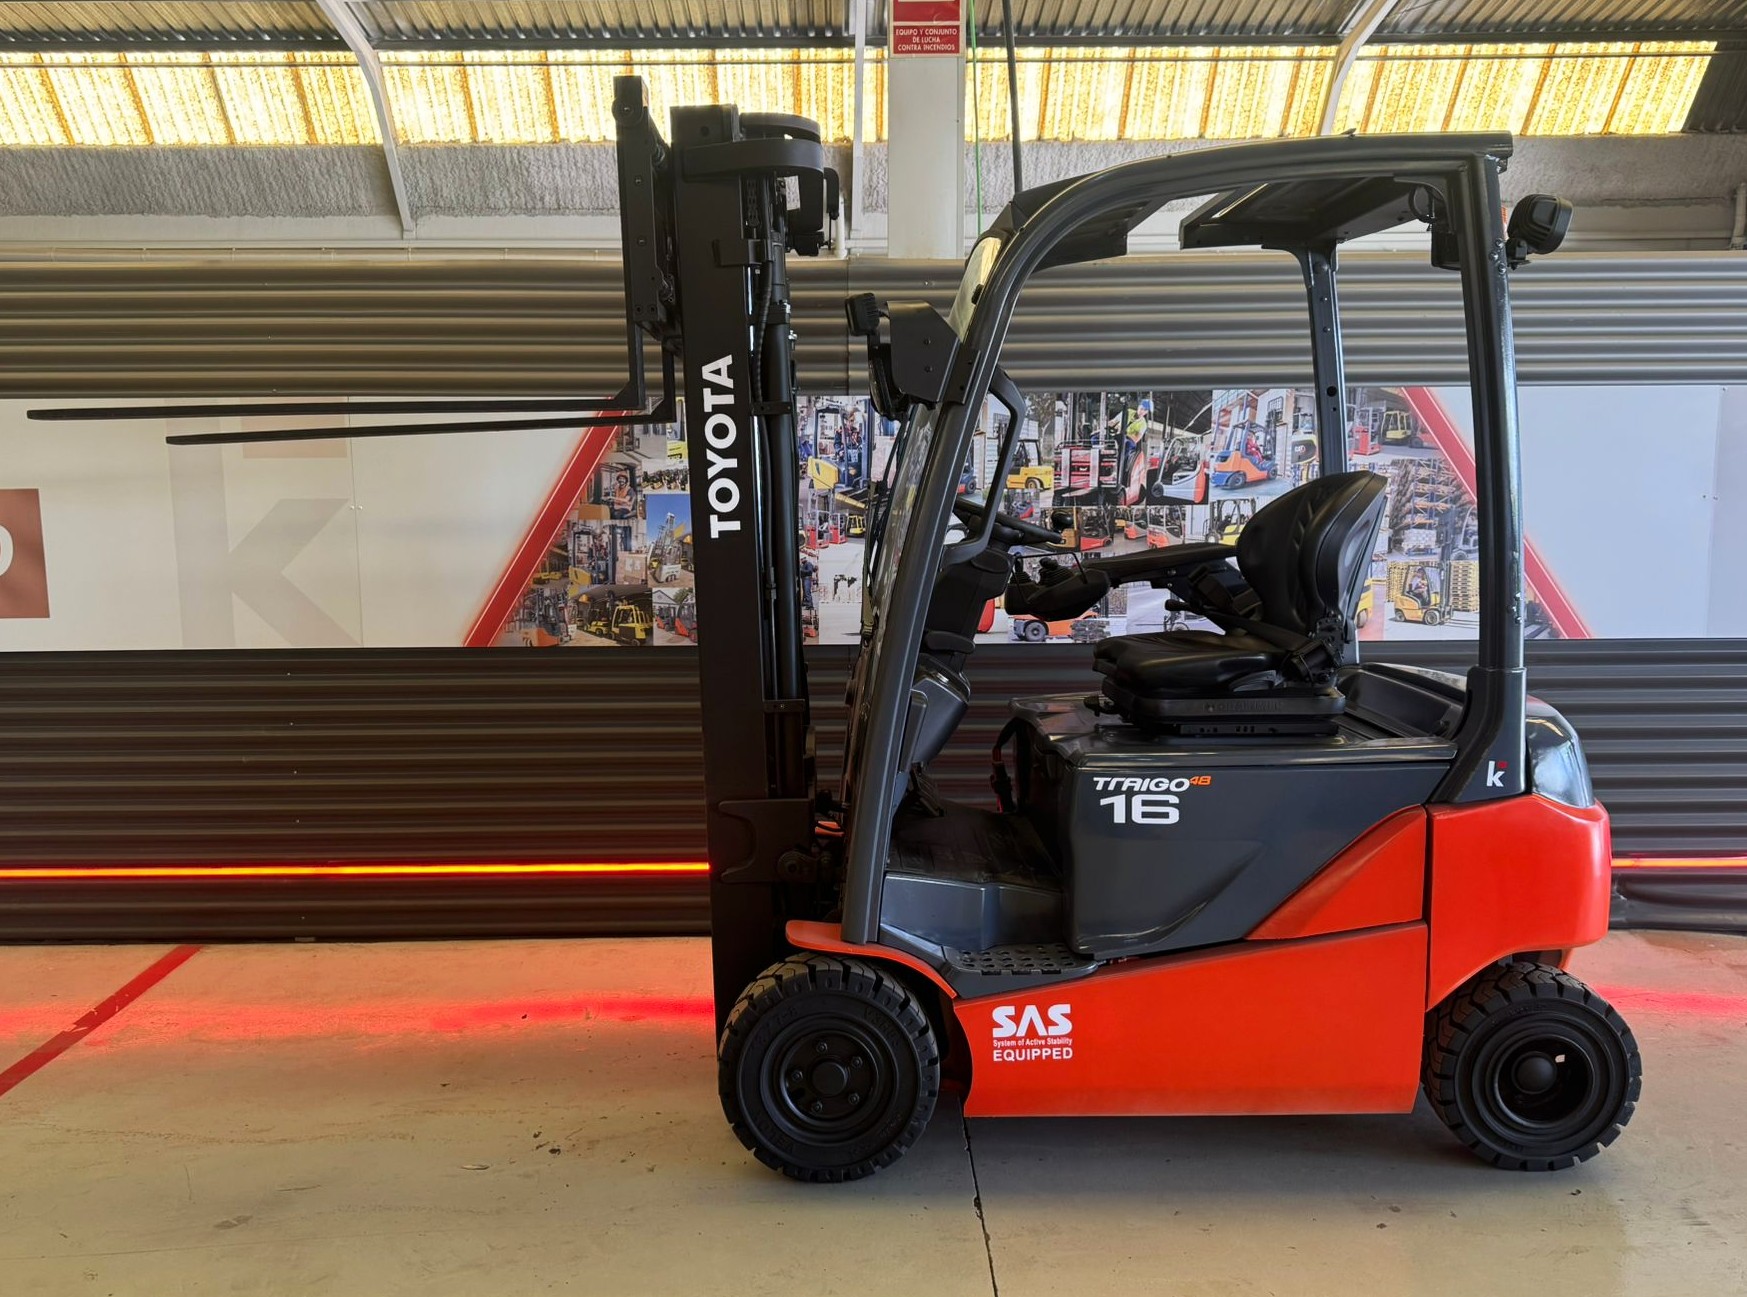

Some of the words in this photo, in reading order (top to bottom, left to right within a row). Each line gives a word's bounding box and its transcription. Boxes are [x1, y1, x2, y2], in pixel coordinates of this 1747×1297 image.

[896, 28, 918, 36] EQUIPO
[925, 28, 958, 36] CONJUNTO
[701, 354, 742, 539] TOYOTA
[1100, 794, 1180, 824] 16
[992, 1004, 1073, 1038] SAS
[993, 1039, 1017, 1049] System
[1018, 1039, 1025, 1047] of
[1025, 1038, 1046, 1047] Active
[1046, 1037, 1073, 1047] Stability
[993, 1047, 1073, 1062] EQUIPPED
